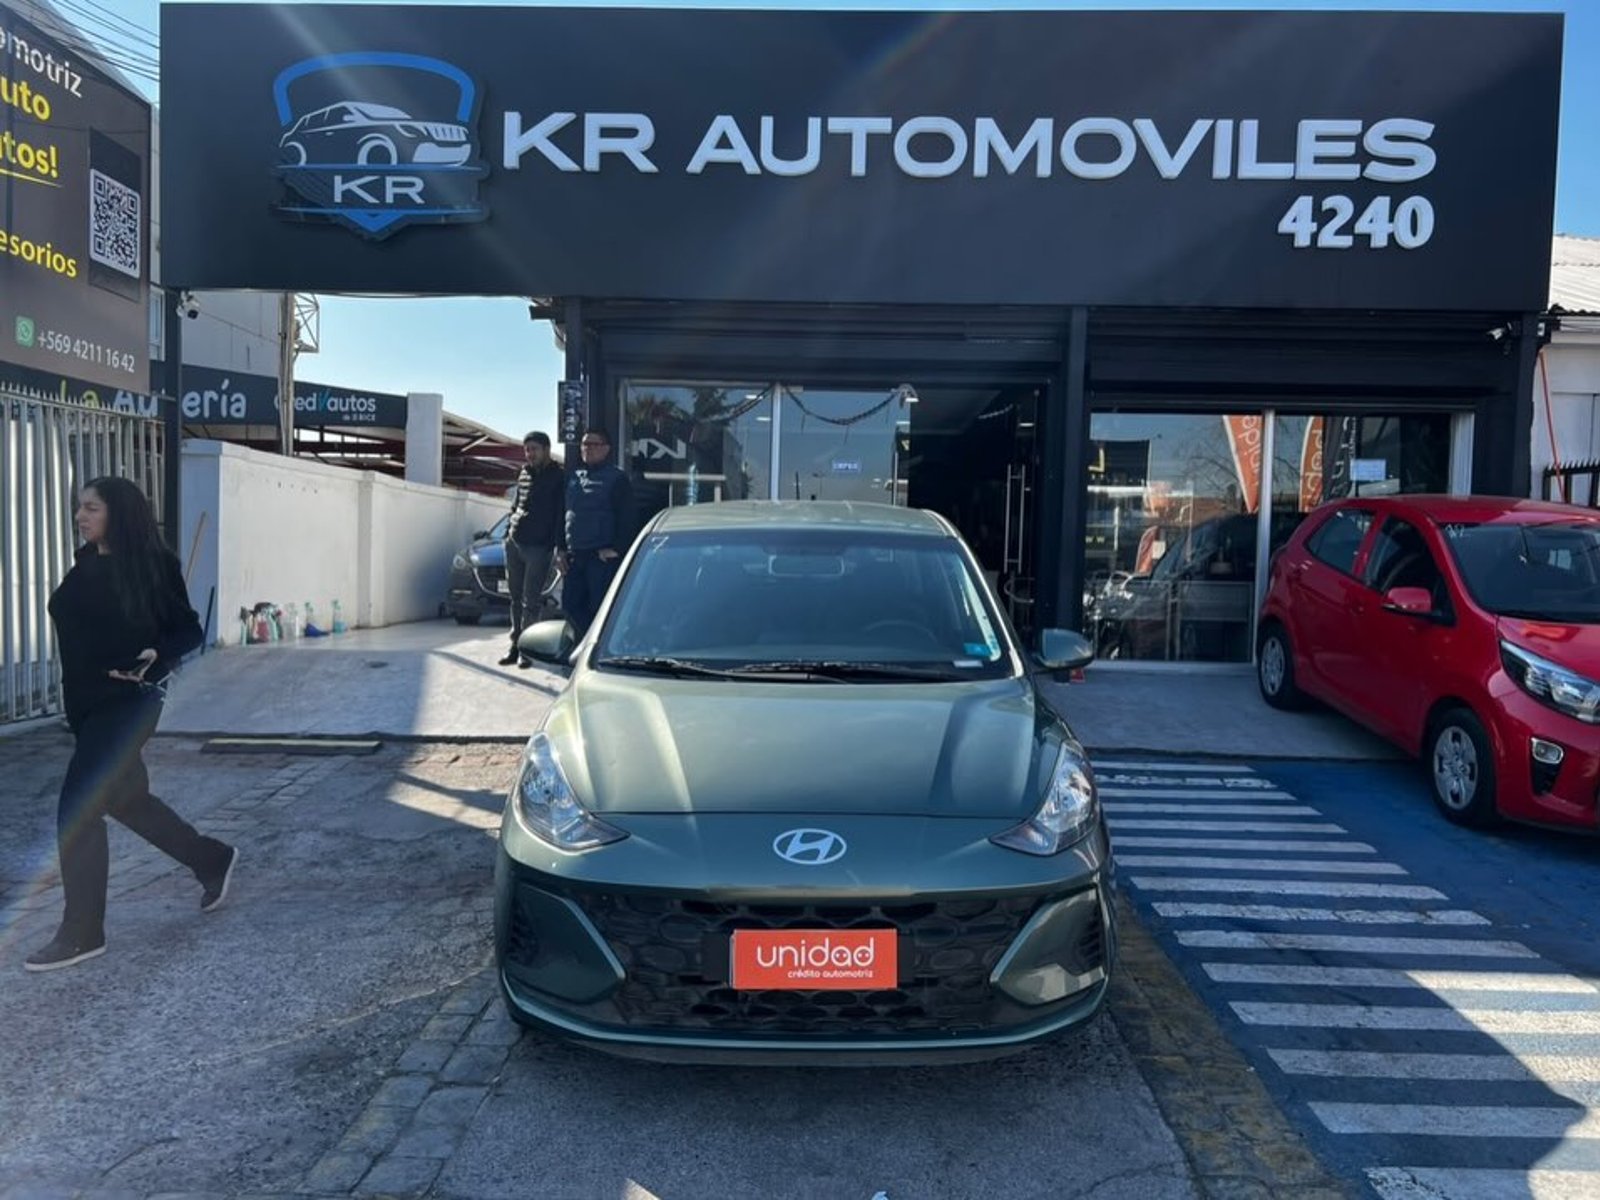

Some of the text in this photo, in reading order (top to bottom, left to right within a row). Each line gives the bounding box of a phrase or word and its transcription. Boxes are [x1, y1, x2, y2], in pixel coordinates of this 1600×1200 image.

[504, 111, 1436, 181] KR AUTOMOVILES
[333, 175, 424, 204] KR
[1278, 195, 1435, 249] 4240
[38, 329, 71, 354] +569
[73, 339, 102, 363] 4211
[757, 936, 874, 967] unidad
[822, 966, 874, 979] automotriz
